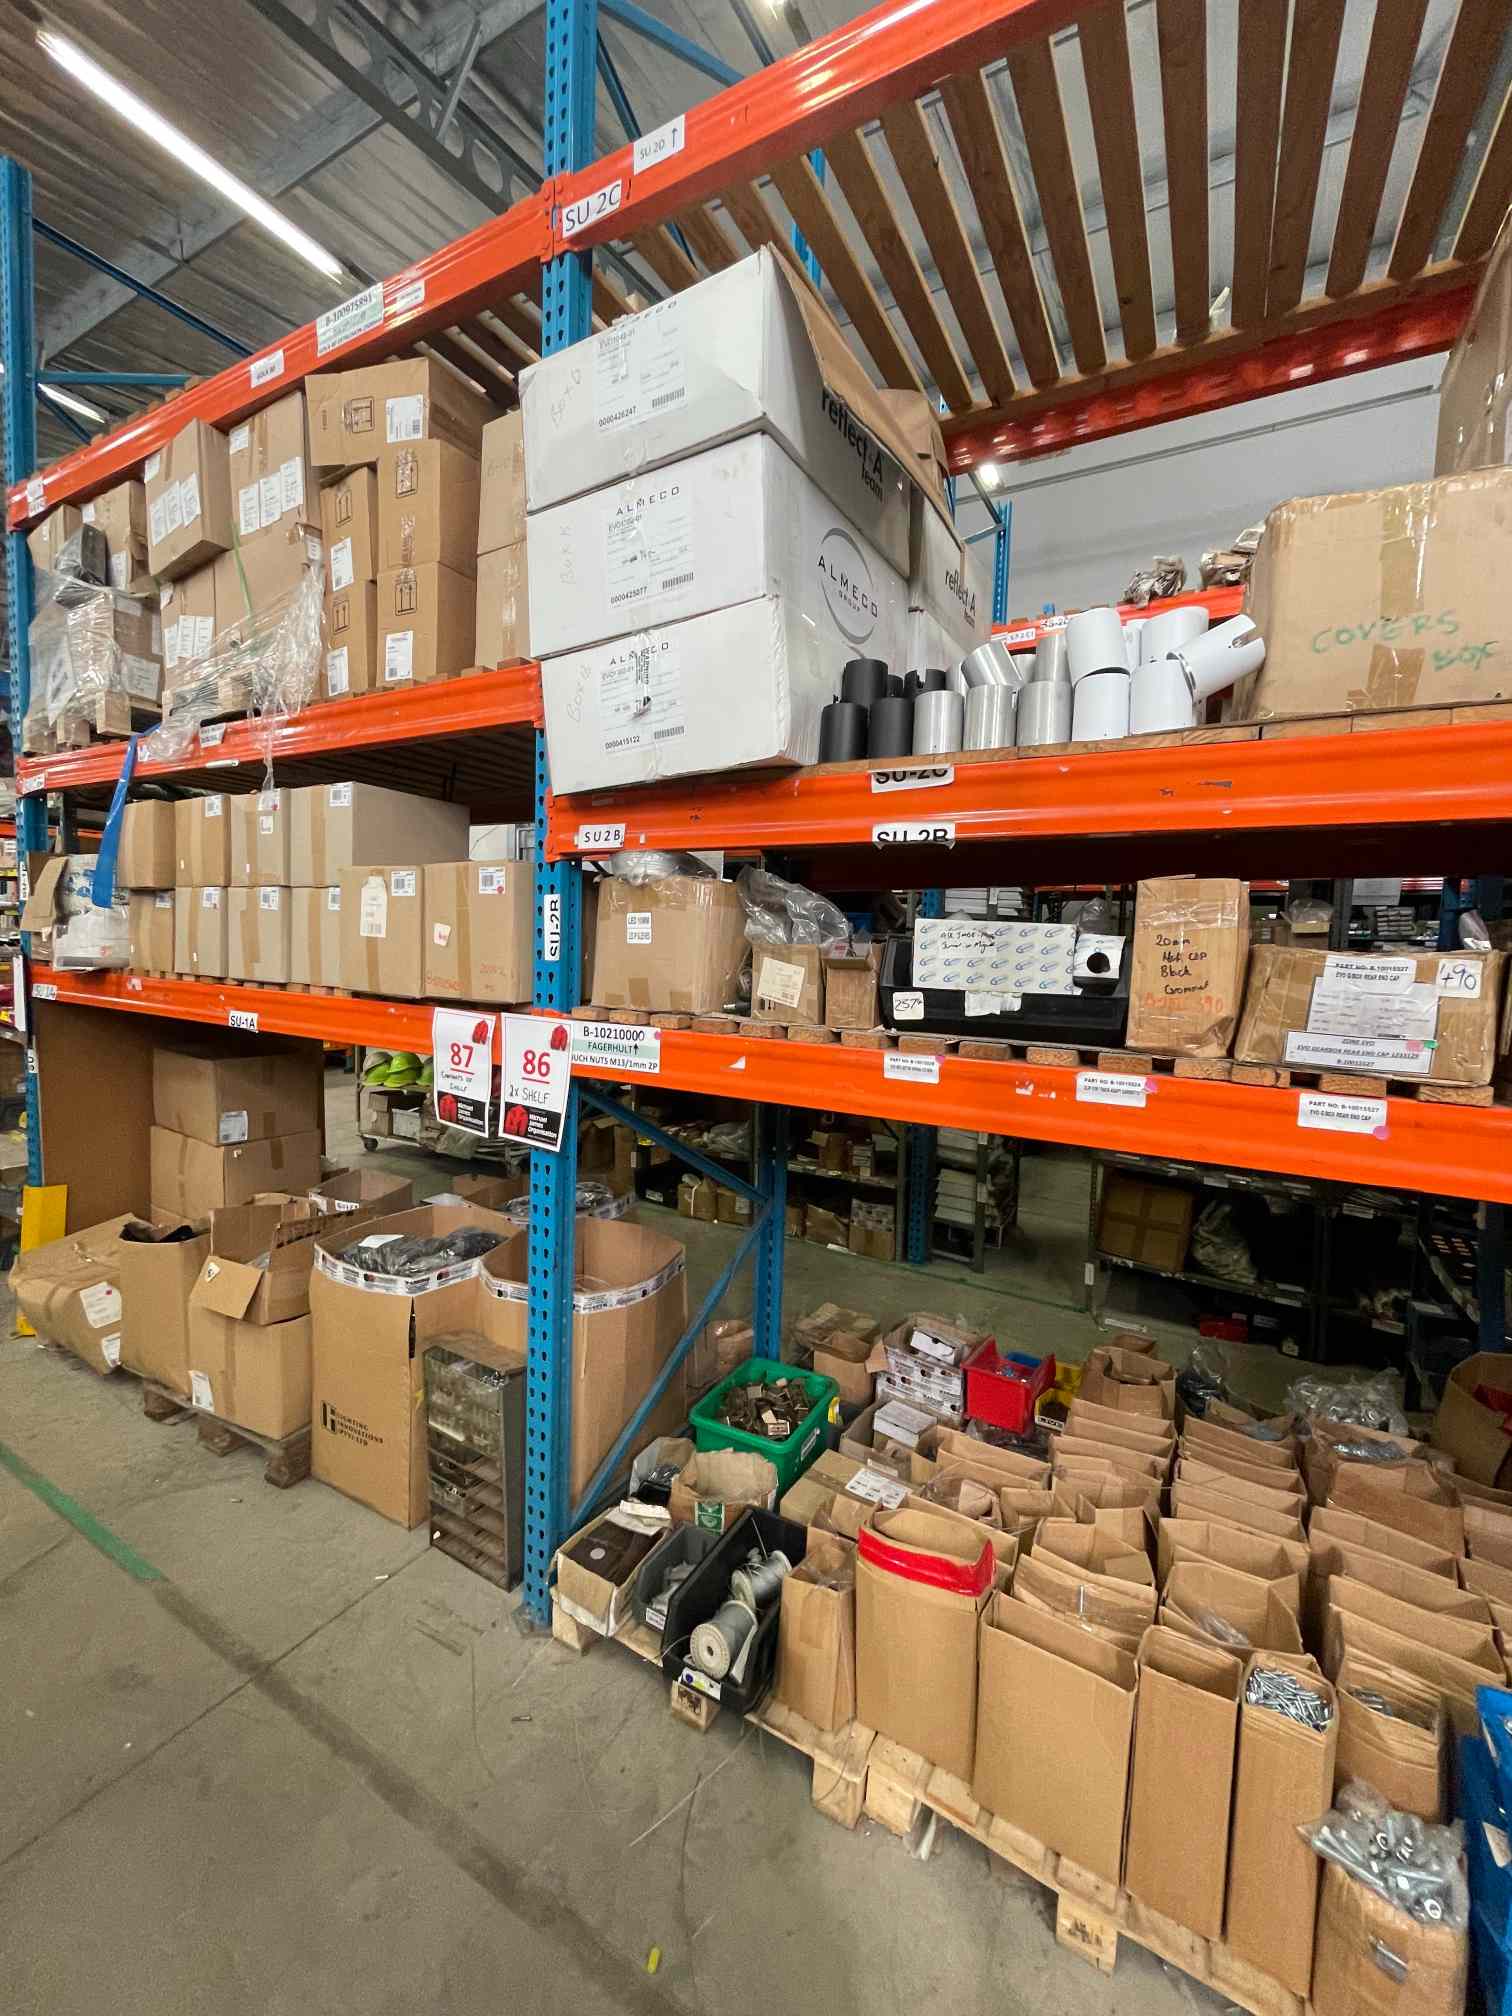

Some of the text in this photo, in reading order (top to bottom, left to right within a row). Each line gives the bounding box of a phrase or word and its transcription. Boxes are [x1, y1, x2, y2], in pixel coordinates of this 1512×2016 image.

[565, 183, 620, 232] SU 2C
[616, 486, 680, 516] ALMECO
[817, 555, 878, 618] ALMECO
[1312, 609, 1458, 654] COVERS
[230, 1015, 256, 1029] SU-1A
[450, 1042, 474, 1068] 87
[588, 1041, 632, 1055] FAGERHULT
[590, 1055, 609, 1065] NUTS
[522, 1049, 551, 1077] 86
[521, 1086, 550, 1105] SHELF
